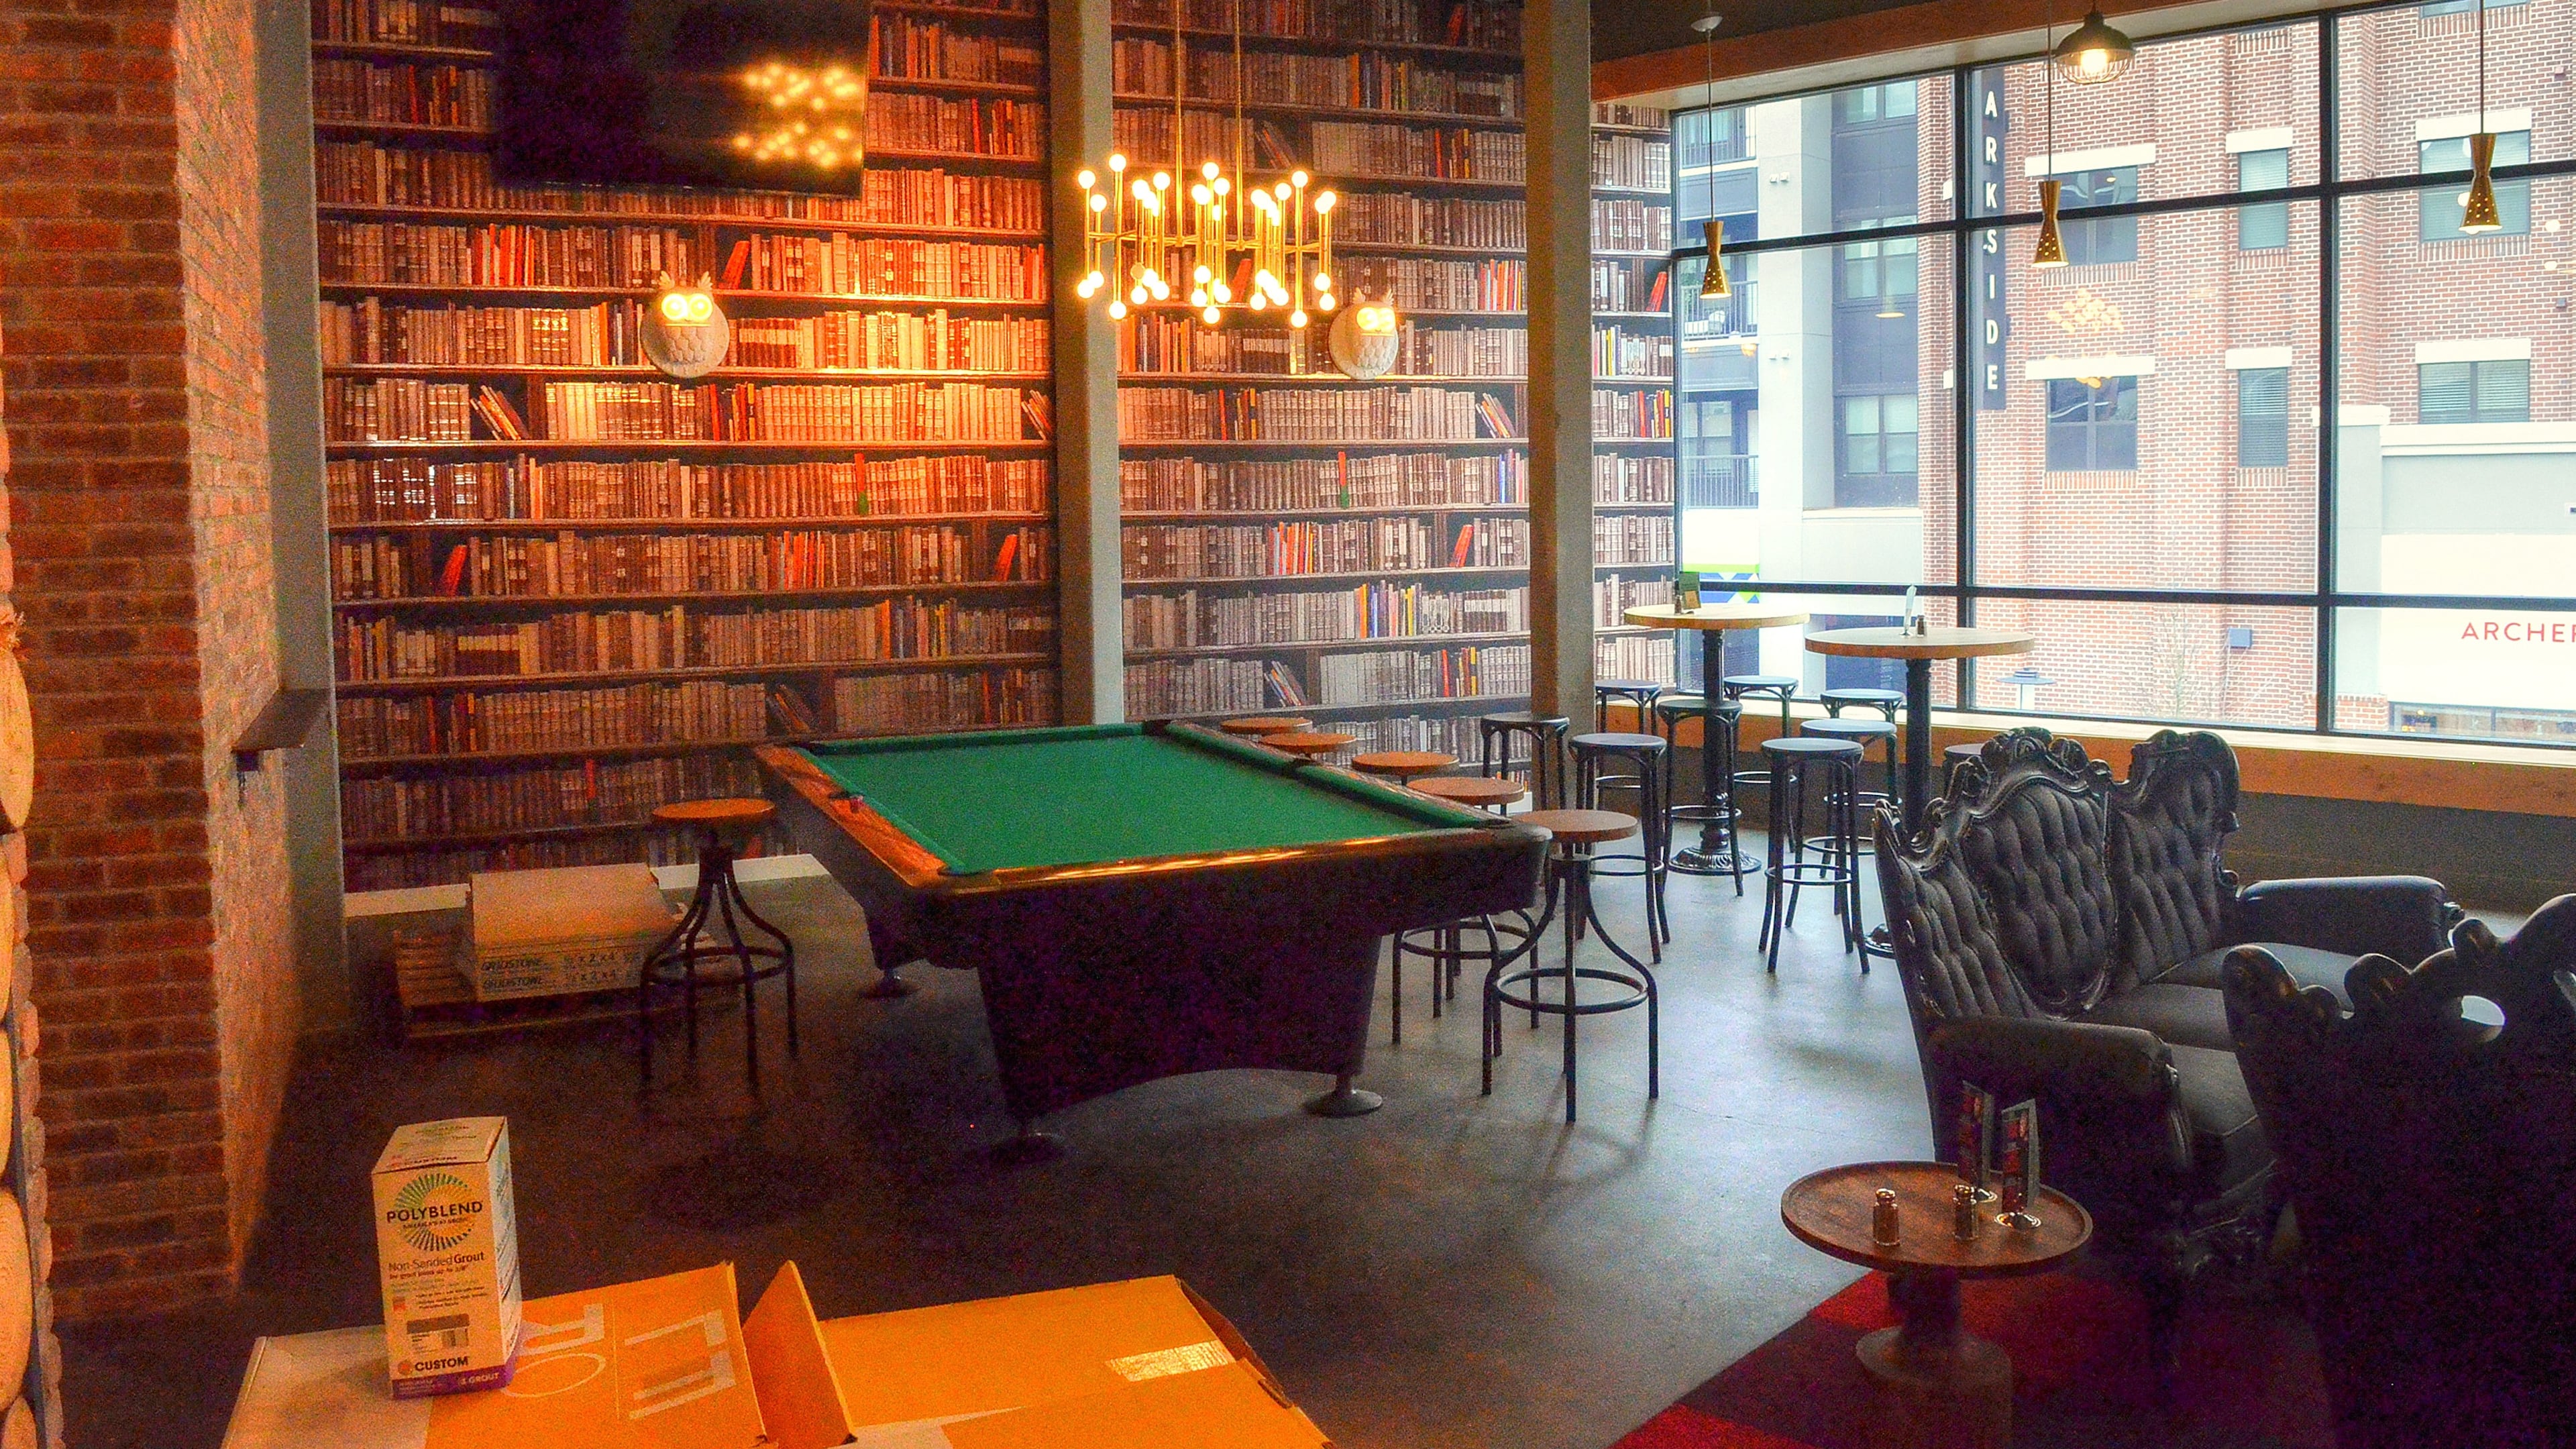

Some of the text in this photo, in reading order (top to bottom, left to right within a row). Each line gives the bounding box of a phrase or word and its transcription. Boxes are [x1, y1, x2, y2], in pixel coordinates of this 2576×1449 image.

[1984, 90, 1998, 390] ARKSIDE
[386, 1201, 483, 1224] POLYBLEND
[453, 1252, 484, 1264] Grout
[415, 1356, 469, 1371] CUSTOM
[468, 1372, 500, 1383] GROUT
